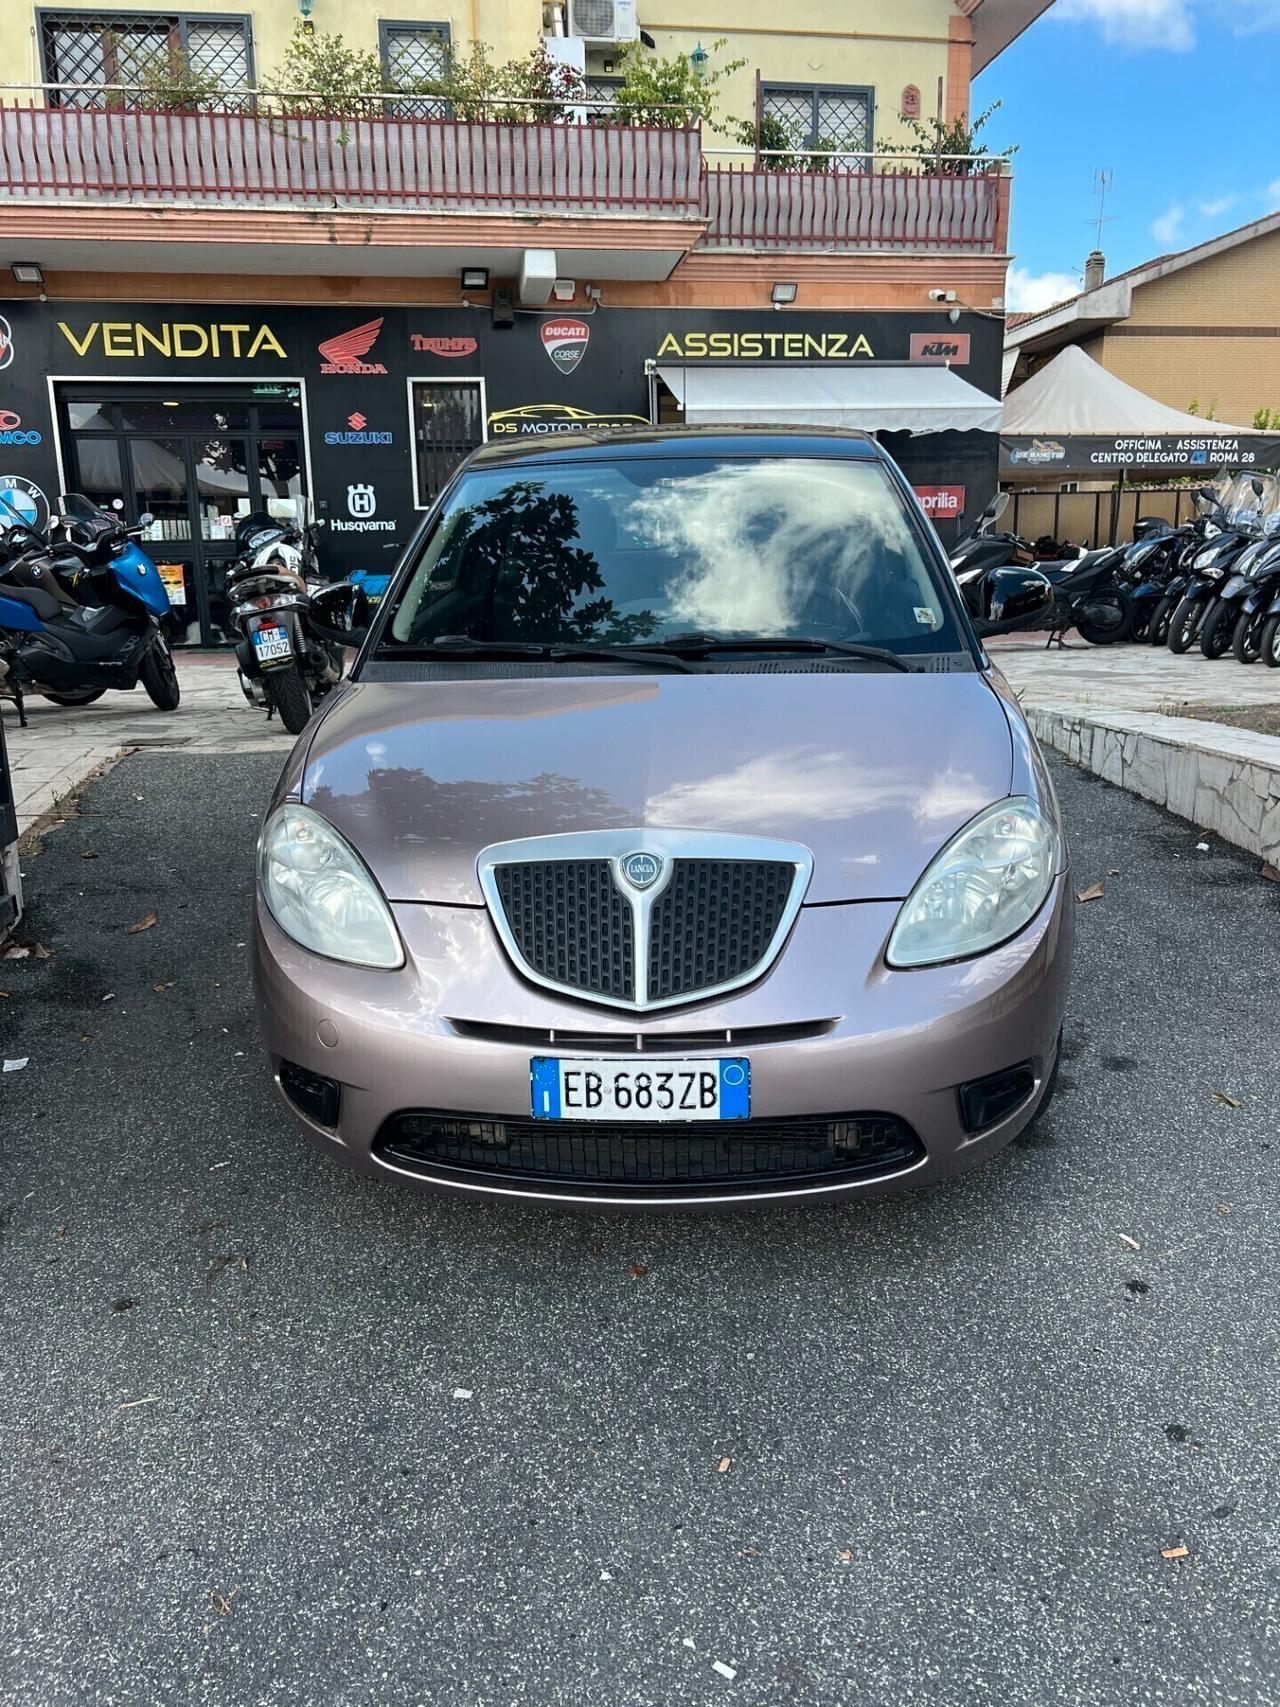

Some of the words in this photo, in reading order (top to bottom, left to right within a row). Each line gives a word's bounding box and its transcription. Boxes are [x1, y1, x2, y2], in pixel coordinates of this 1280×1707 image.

[545, 327, 586, 336] DUCATI
[57, 322, 288, 358] VENDITA
[657, 333, 874, 357] ASSISTENZA
[554, 350, 580, 358] CORSE
[921, 342, 959, 356] KTM
[320, 363, 388, 374] HONDA
[493, 423, 518, 433] DS
[0, 431, 42, 445] MCO
[324, 432, 393, 444] SUZUKI
[1114, 440, 1162, 450] OFFICINA
[1176, 440, 1239, 450] ASSISTENZA
[1090, 452, 1134, 463] CENTRO
[1136, 452, 1188, 463] DELEGATO
[1209, 452, 1238, 462] ROMA
[1241, 452, 1255, 462] 28
[917, 492, 958, 509] prilia
[330, 519, 396, 533] Husqvarna
[261, 630, 274, 642] CM
[259, 642, 289, 657] 17052
[630, 864, 654, 873] LANCIA
[564, 1071, 602, 1109] EB
[614, 1072, 717, 1109] 683ZB
